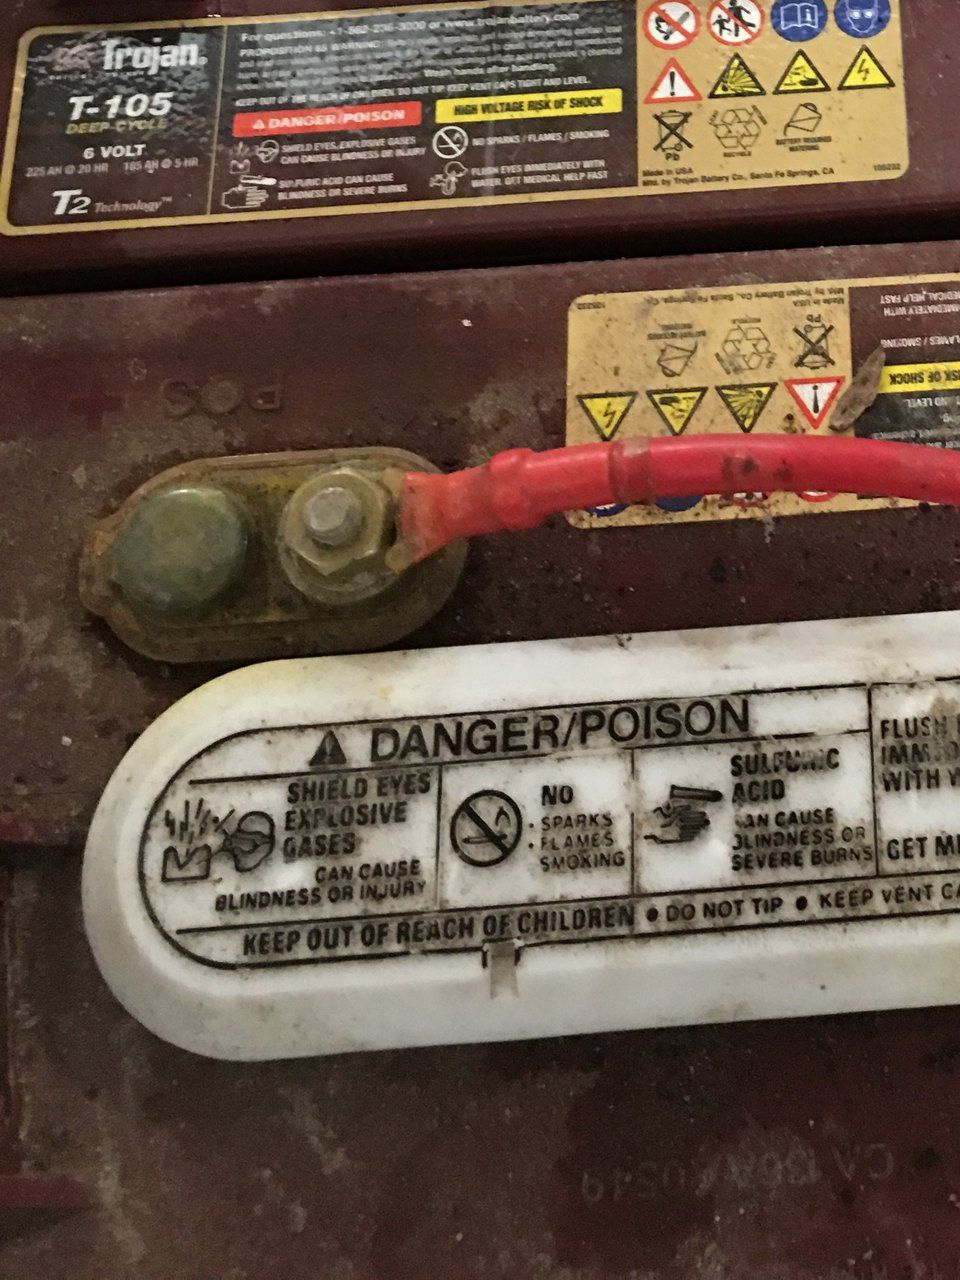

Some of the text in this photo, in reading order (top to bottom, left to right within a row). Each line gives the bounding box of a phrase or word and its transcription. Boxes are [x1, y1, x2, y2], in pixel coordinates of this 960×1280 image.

[101, 36, 199, 76] Trojan
[68, 91, 175, 121] T-105
[453, 95, 604, 117] HIGH VOLTAGE RISK OF SHOCK
[82, 143, 147, 160] 6 VOLT
[51, 188, 92, 216] T2
[889, 372, 926, 386] SHOCK
[370, 699, 750, 763] DANGER/POISON
[880, 714, 948, 741] FLUSH
[287, 772, 431, 805] SHIELD EYES
[731, 779, 786, 805] ACID
[881, 767, 941, 793] WITH
[540, 785, 574, 806] NO
[283, 801, 408, 832] EXPLOSIVE
[540, 812, 614, 832] SPARKS
[774, 807, 835, 828] CAUSE
[282, 831, 356, 860] GASES
[540, 831, 615, 851] FLAMES
[841, 825, 867, 843] OR
[730, 845, 874, 872] SEVERE BURNS
[886, 835, 928, 861] GET
[314, 859, 421, 884] CAN CAUSE
[540, 851, 626, 873] SMOKING
[214, 879, 427, 913] BLINDNESS OR INJURY
[242, 930, 303, 956] KEEP
[306, 926, 356, 952] OUT
[359, 923, 391, 948] OF
[396, 918, 475, 945] REACH
[481, 914, 513, 938] OF
[517, 906, 636, 935] CHILDREN
[665, 902, 696, 924] DO
[701, 898, 745, 921] NOT
[750, 895, 784, 916] TIP
[818, 887, 875, 910] KEEP
[880, 883, 935, 905] VENT
